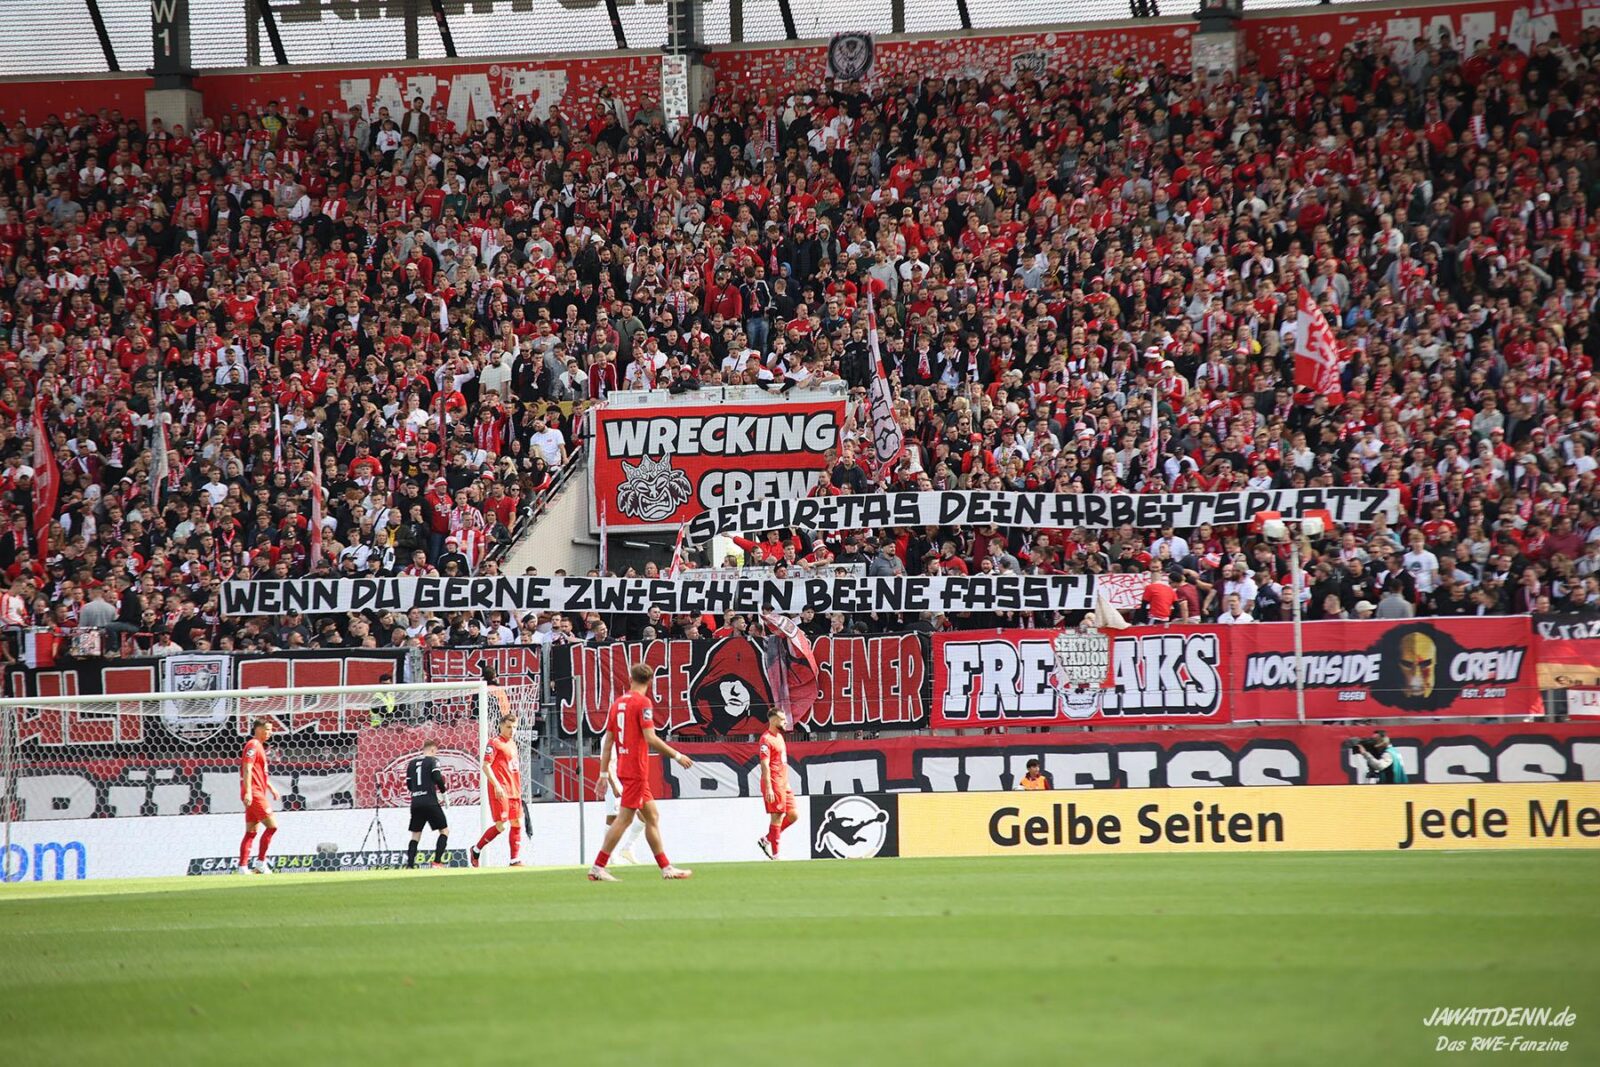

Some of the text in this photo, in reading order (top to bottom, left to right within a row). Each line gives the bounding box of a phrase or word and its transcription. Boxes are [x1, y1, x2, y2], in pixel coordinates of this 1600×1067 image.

[604, 412, 838, 457] WRECKING
[223, 577, 340, 613] WENN
[350, 577, 400, 610] DU
[412, 577, 550, 611] GERNE
[940, 573, 1096, 610] FASST!
[430, 647, 541, 677] SEKTION
[944, 635, 1219, 718] FREAKS
[1059, 652, 1108, 666] TADION
[1065, 665, 1108, 680] ERBOT
[1246, 650, 1524, 687] NORTHSIDE CREW
[560, 638, 697, 735] JUNGE
[804, 634, 925, 727] SENER
[616, 711, 625, 745] 9
[415, 766, 422, 786] 1
[989, 803, 1121, 847] Gelbe
[1138, 801, 1283, 844] Seiten
[1398, 798, 1508, 849] Jede
